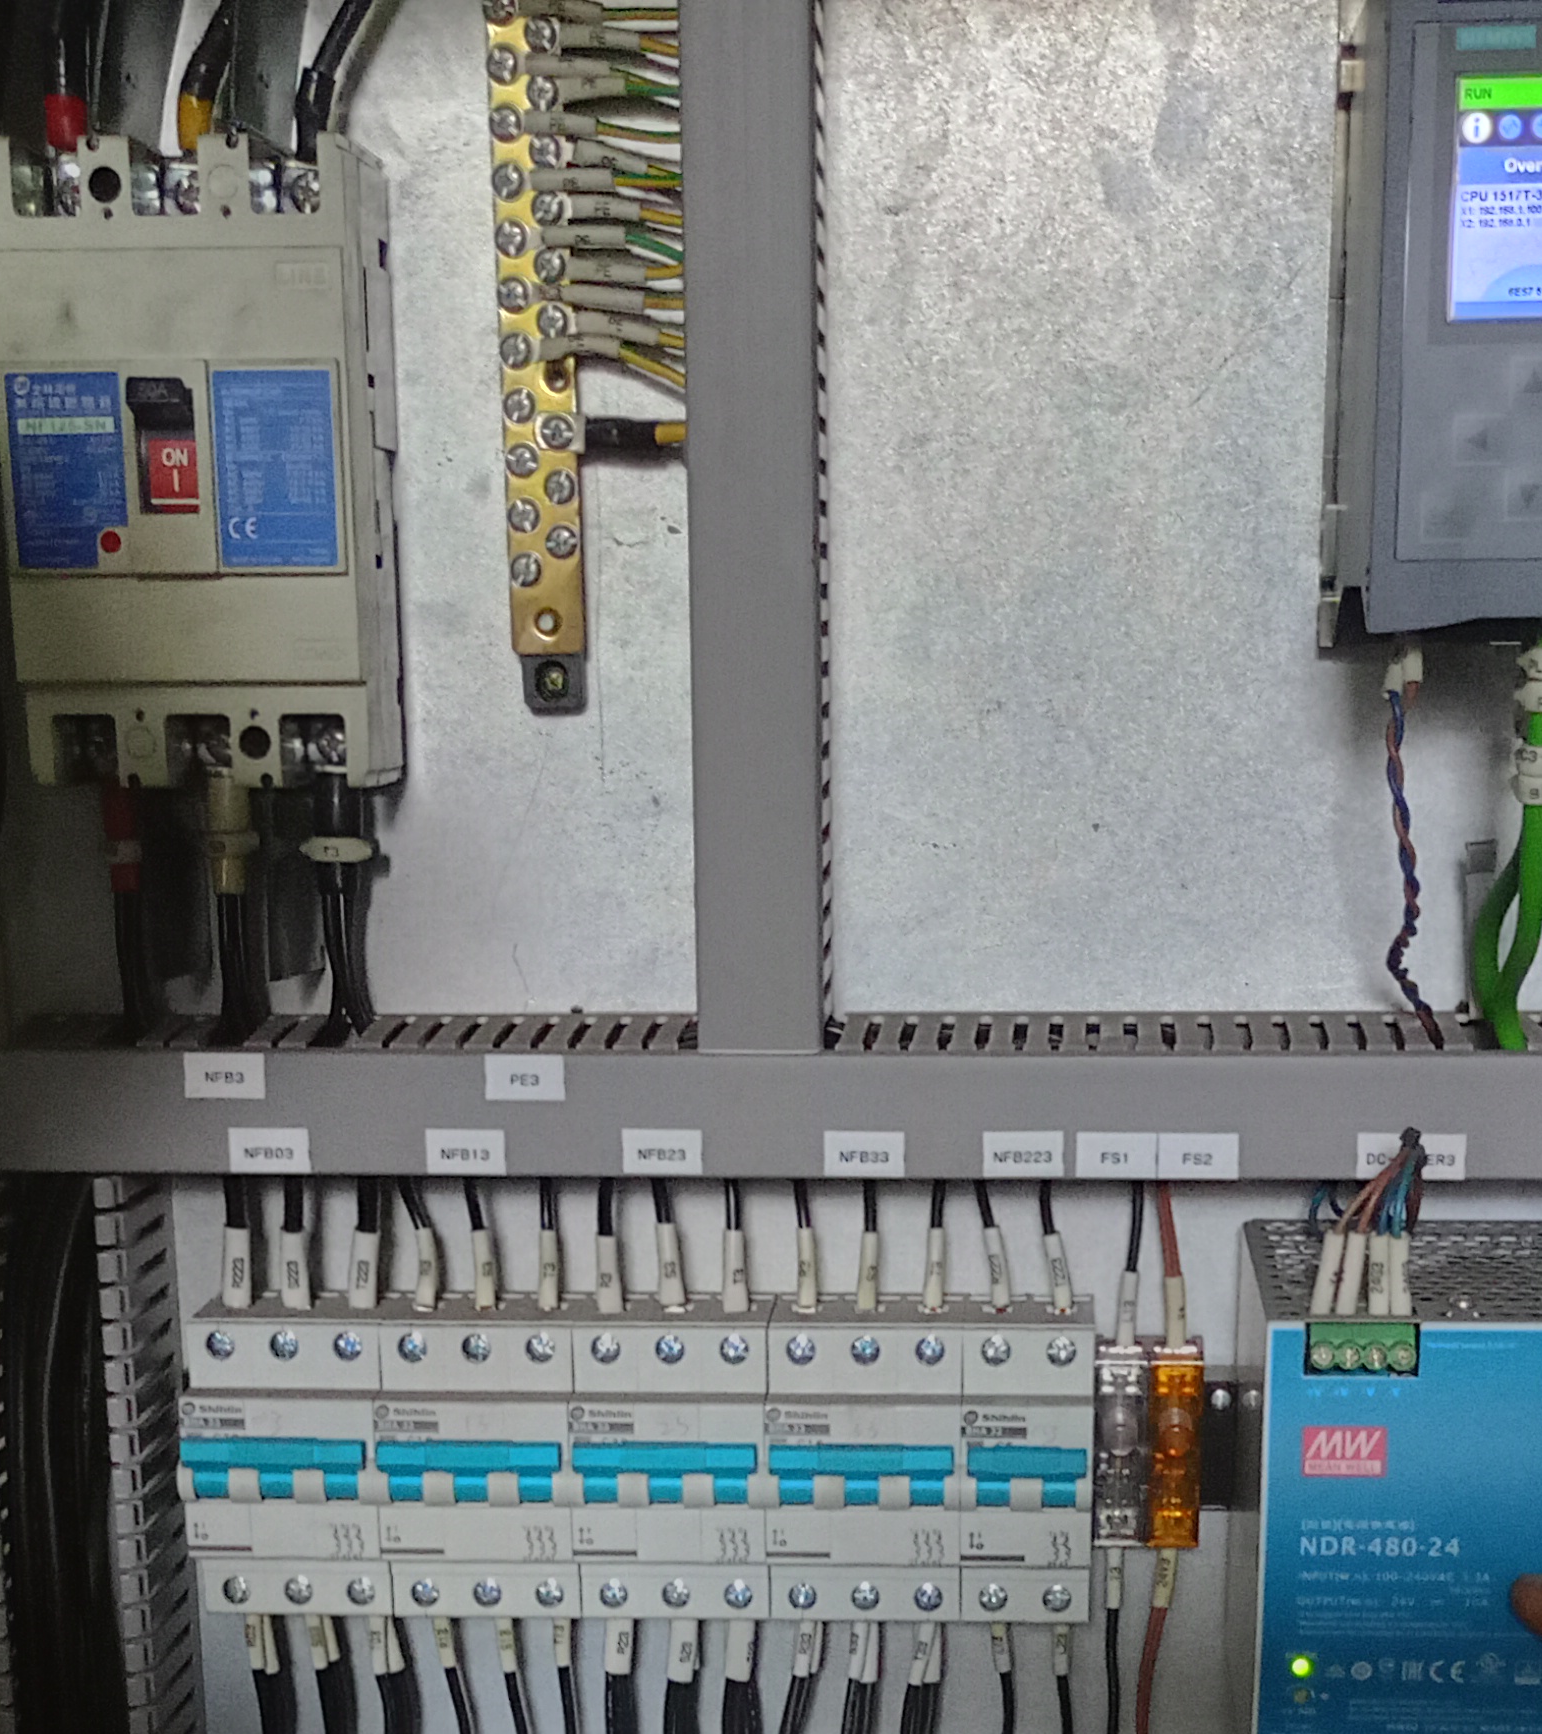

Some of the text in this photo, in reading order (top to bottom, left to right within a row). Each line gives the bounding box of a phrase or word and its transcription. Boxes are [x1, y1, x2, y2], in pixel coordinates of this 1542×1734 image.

[1464, 87, 1492, 100] RUN
[1461, 190, 1488, 202] CPU
[162, 448, 188, 466] ON
[205, 1071, 245, 1084] NFB3
[510, 1073, 540, 1086] PE3
[244, 1147, 294, 1160] NFB03
[440, 1148, 491, 1161] NFB13
[637, 1149, 686, 1162] NFB23
[839, 1150, 889, 1163] NFB33
[993, 1150, 1053, 1163] NFB223
[1100, 1152, 1128, 1165] FS1
[1182, 1152, 1213, 1166] FS2
[1300, 1537, 1460, 1557] NDR-480-24
